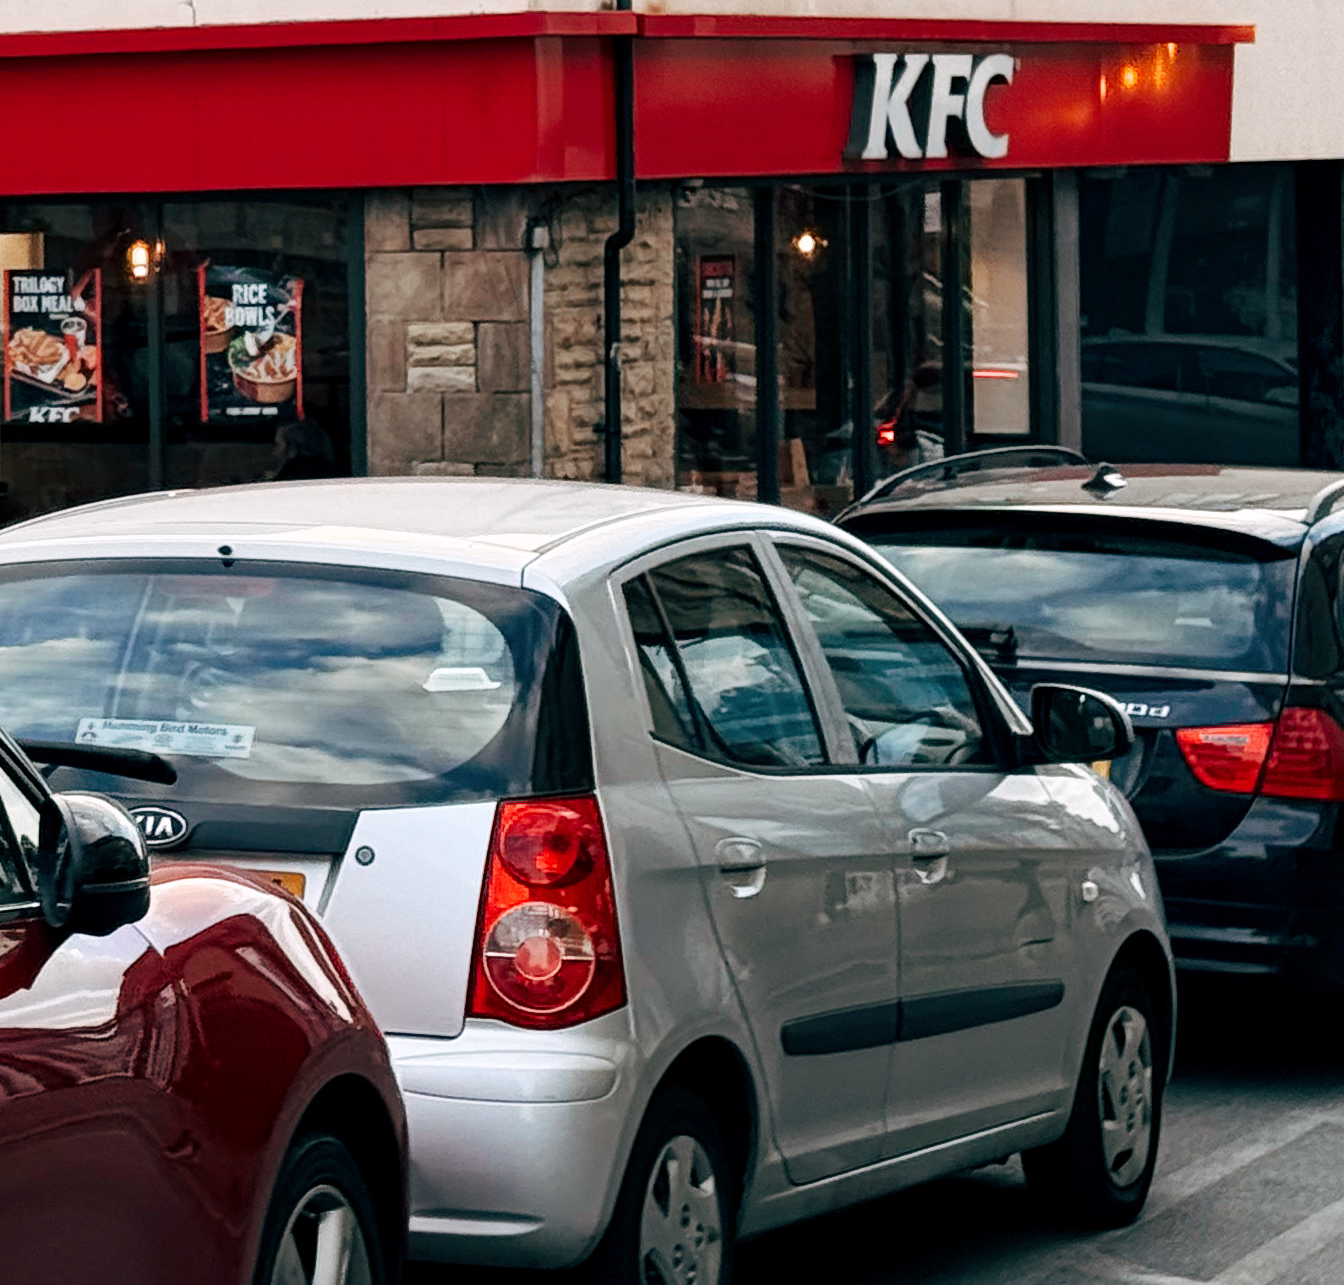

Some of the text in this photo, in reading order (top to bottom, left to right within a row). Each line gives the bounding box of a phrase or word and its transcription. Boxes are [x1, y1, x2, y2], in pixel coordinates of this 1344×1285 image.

[862, 53, 1013, 160] KFC
[12, 276, 65, 294] TRILOGY
[232, 284, 267, 304] RICE
[13, 295, 73, 313] BOX MEAL
[224, 306, 275, 327] BOWLS
[187, 725, 228, 736] Motors
[134, 815, 174, 836] IA
